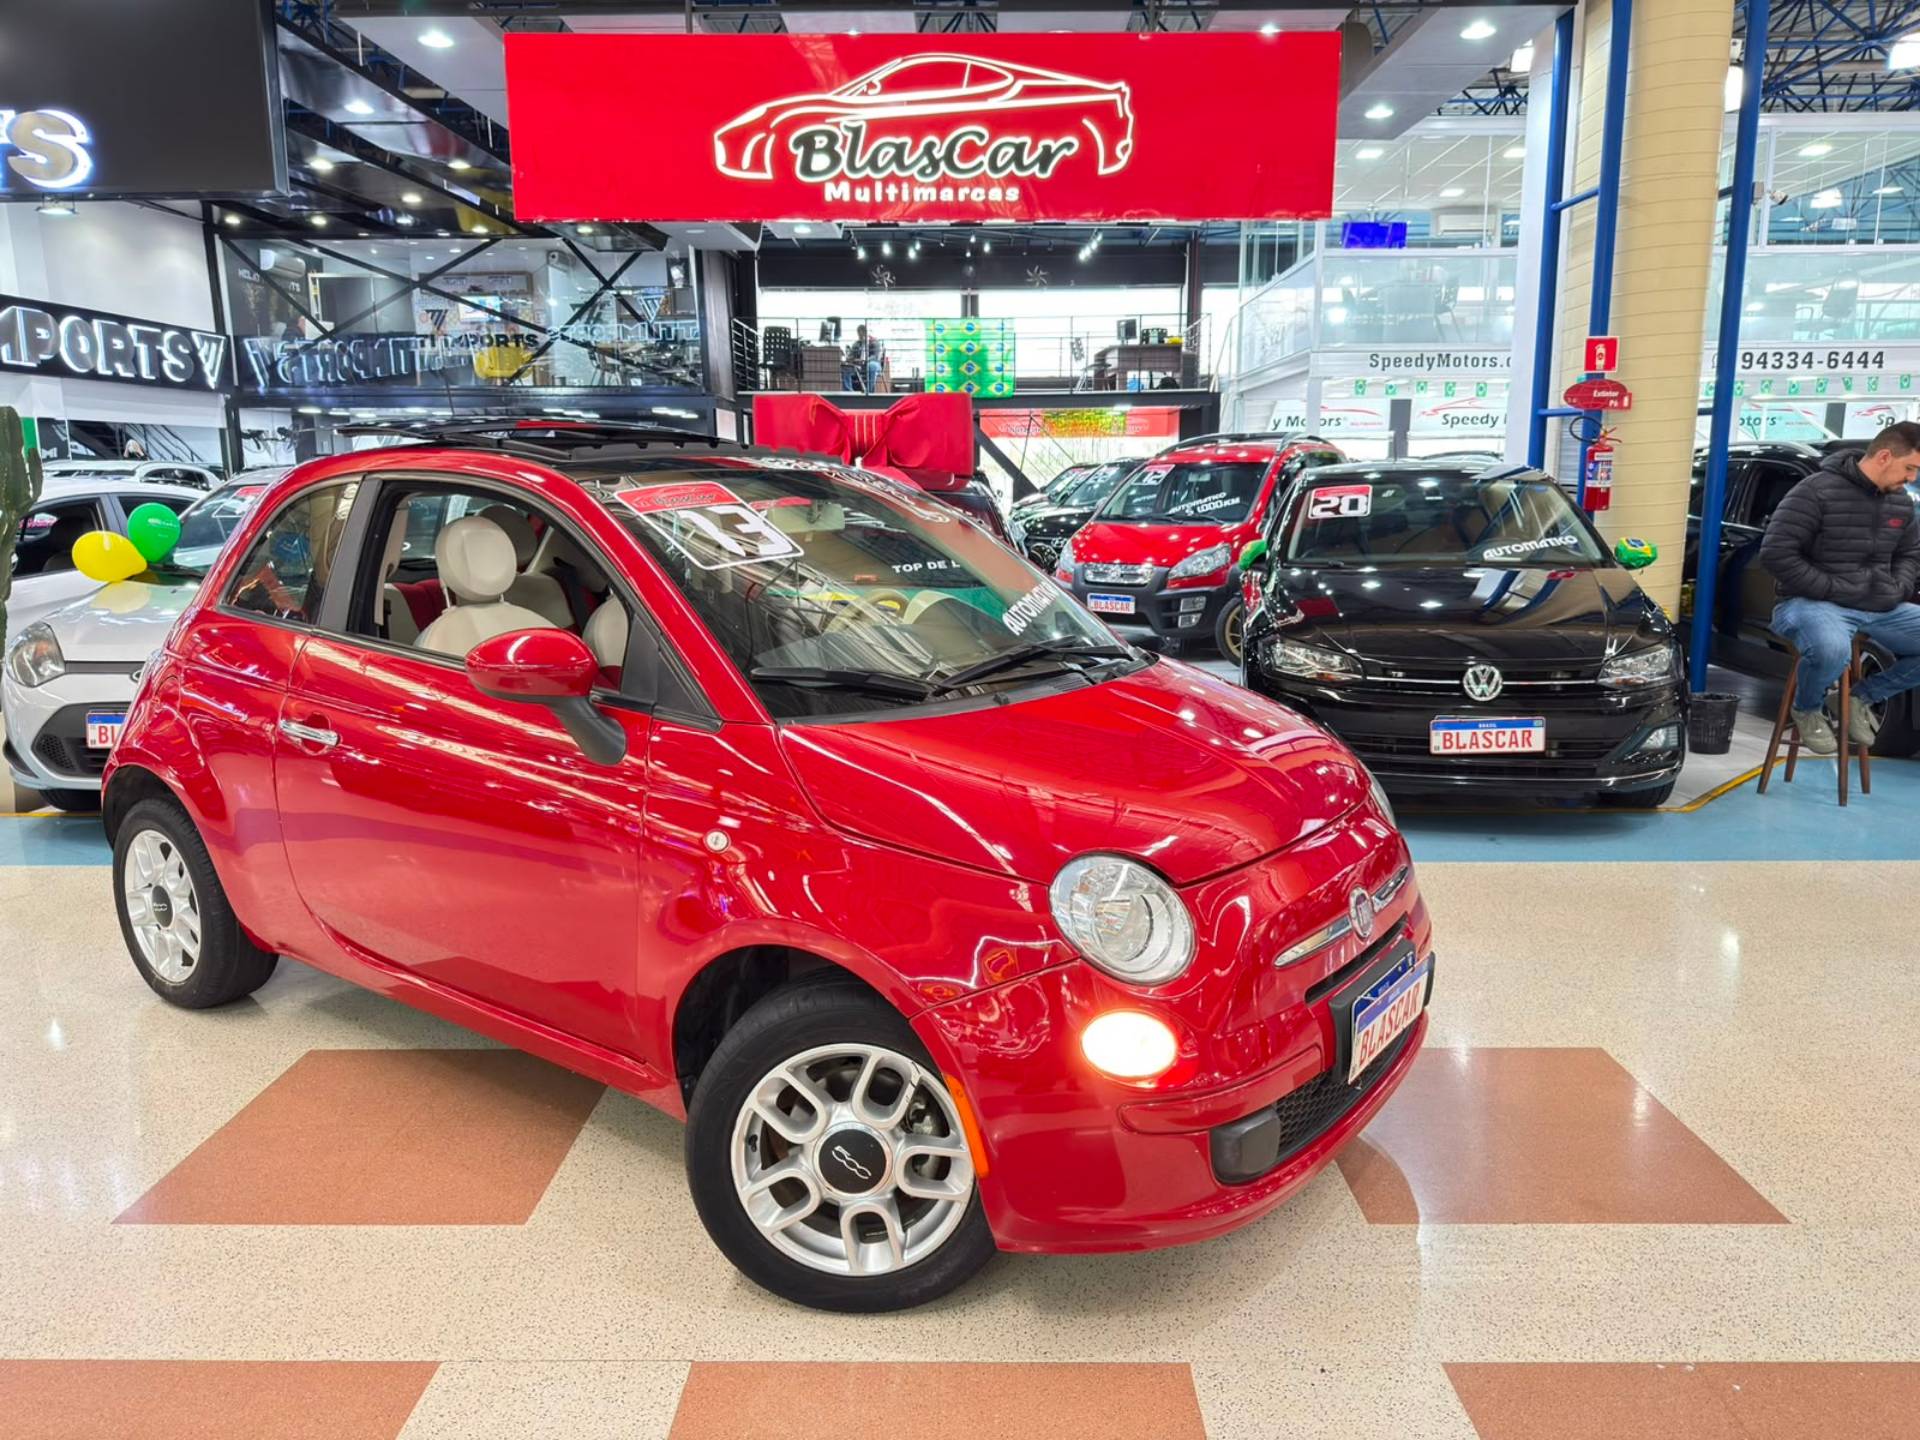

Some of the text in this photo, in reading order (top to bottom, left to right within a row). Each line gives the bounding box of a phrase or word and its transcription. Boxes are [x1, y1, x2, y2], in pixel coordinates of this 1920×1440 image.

[789, 120, 1079, 182] BlasCar
[824, 182, 1020, 203] Multimarcas
[1741, 351, 1884, 370] 94334-6444
[1441, 412, 1499, 430] Speedy
[1312, 495, 1368, 517] 20
[677, 505, 793, 557] 13
[892, 562, 923, 574] TOP
[927, 560, 947, 570] DE
[1094, 600, 1131, 612] BLASCAR
[1442, 730, 1533, 749] BLASCAR
[1359, 982, 1420, 1067] BLASCAR
